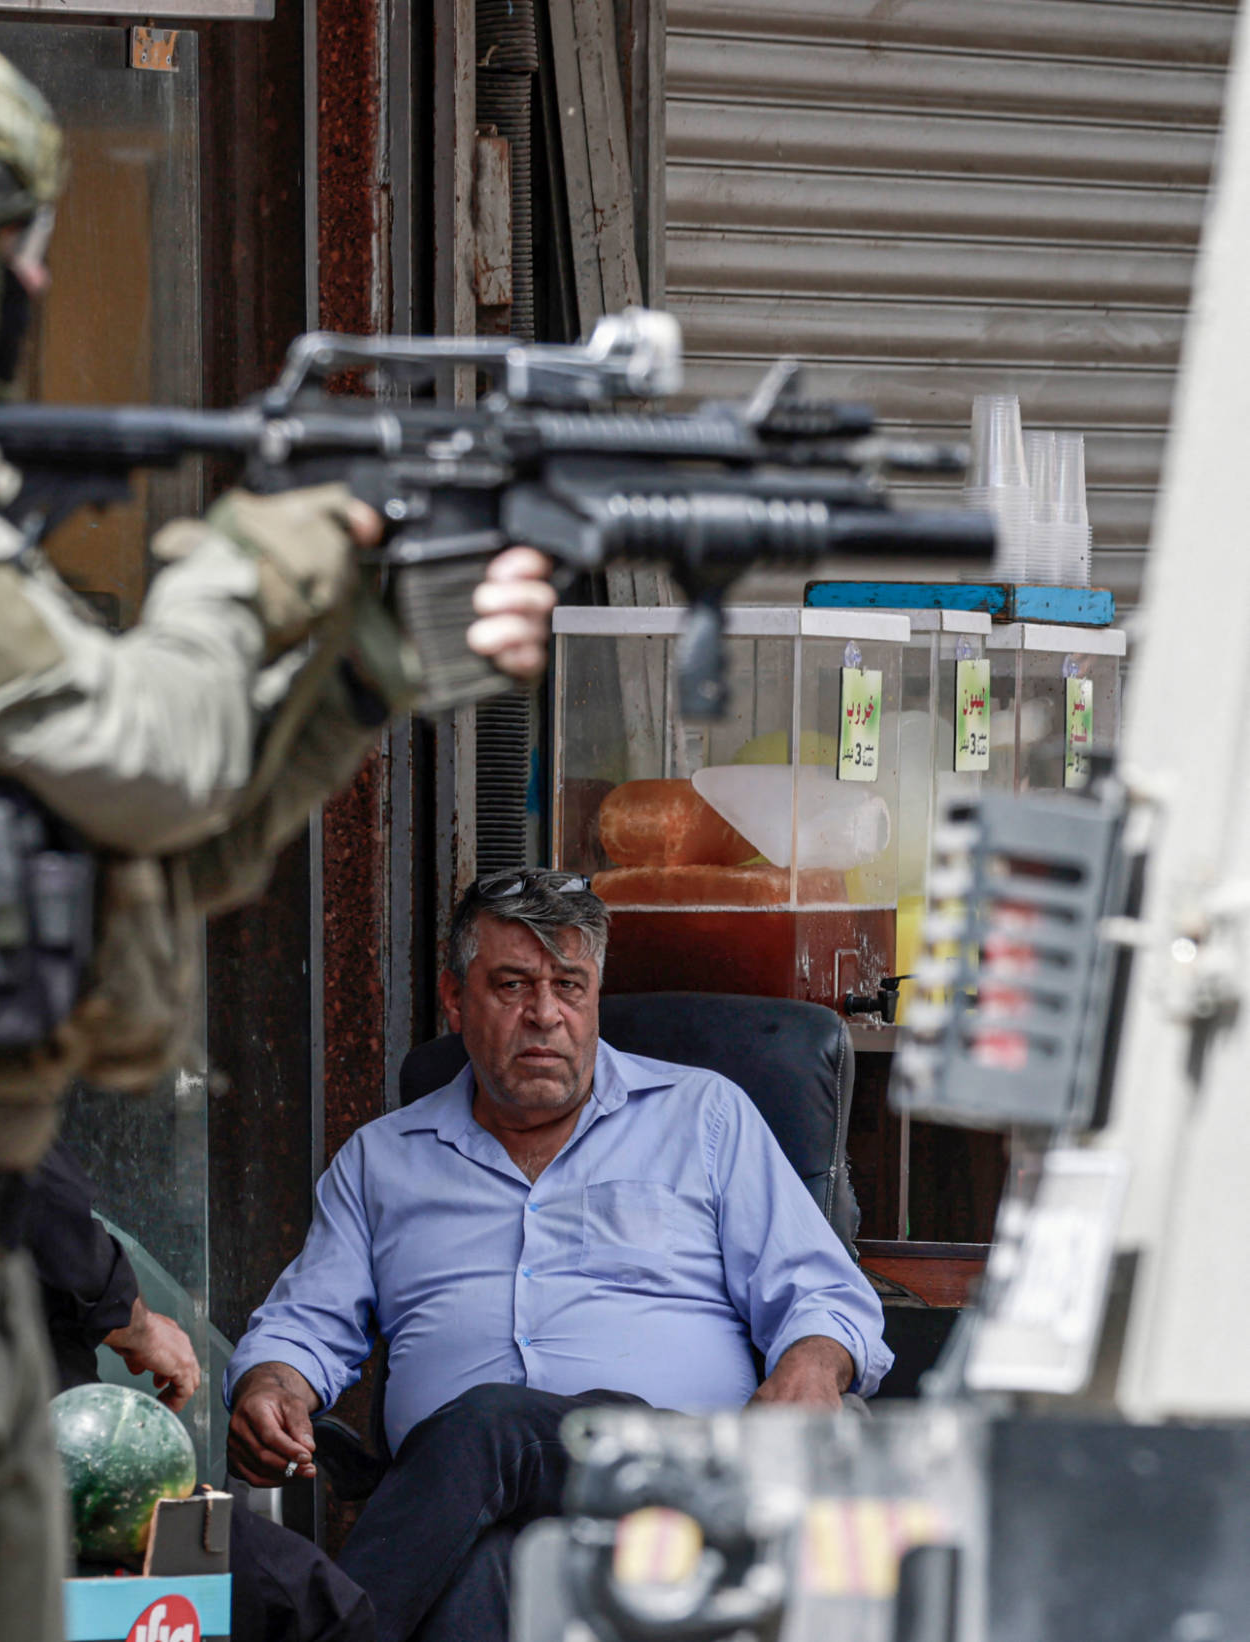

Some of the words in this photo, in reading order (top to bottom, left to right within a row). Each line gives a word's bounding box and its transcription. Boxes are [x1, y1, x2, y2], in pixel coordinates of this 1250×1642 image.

[846, 695, 875, 726] خروب
[963, 687, 985, 716] ليمون
[855, 742, 862, 765] 3
[970, 733, 976, 755] 3
